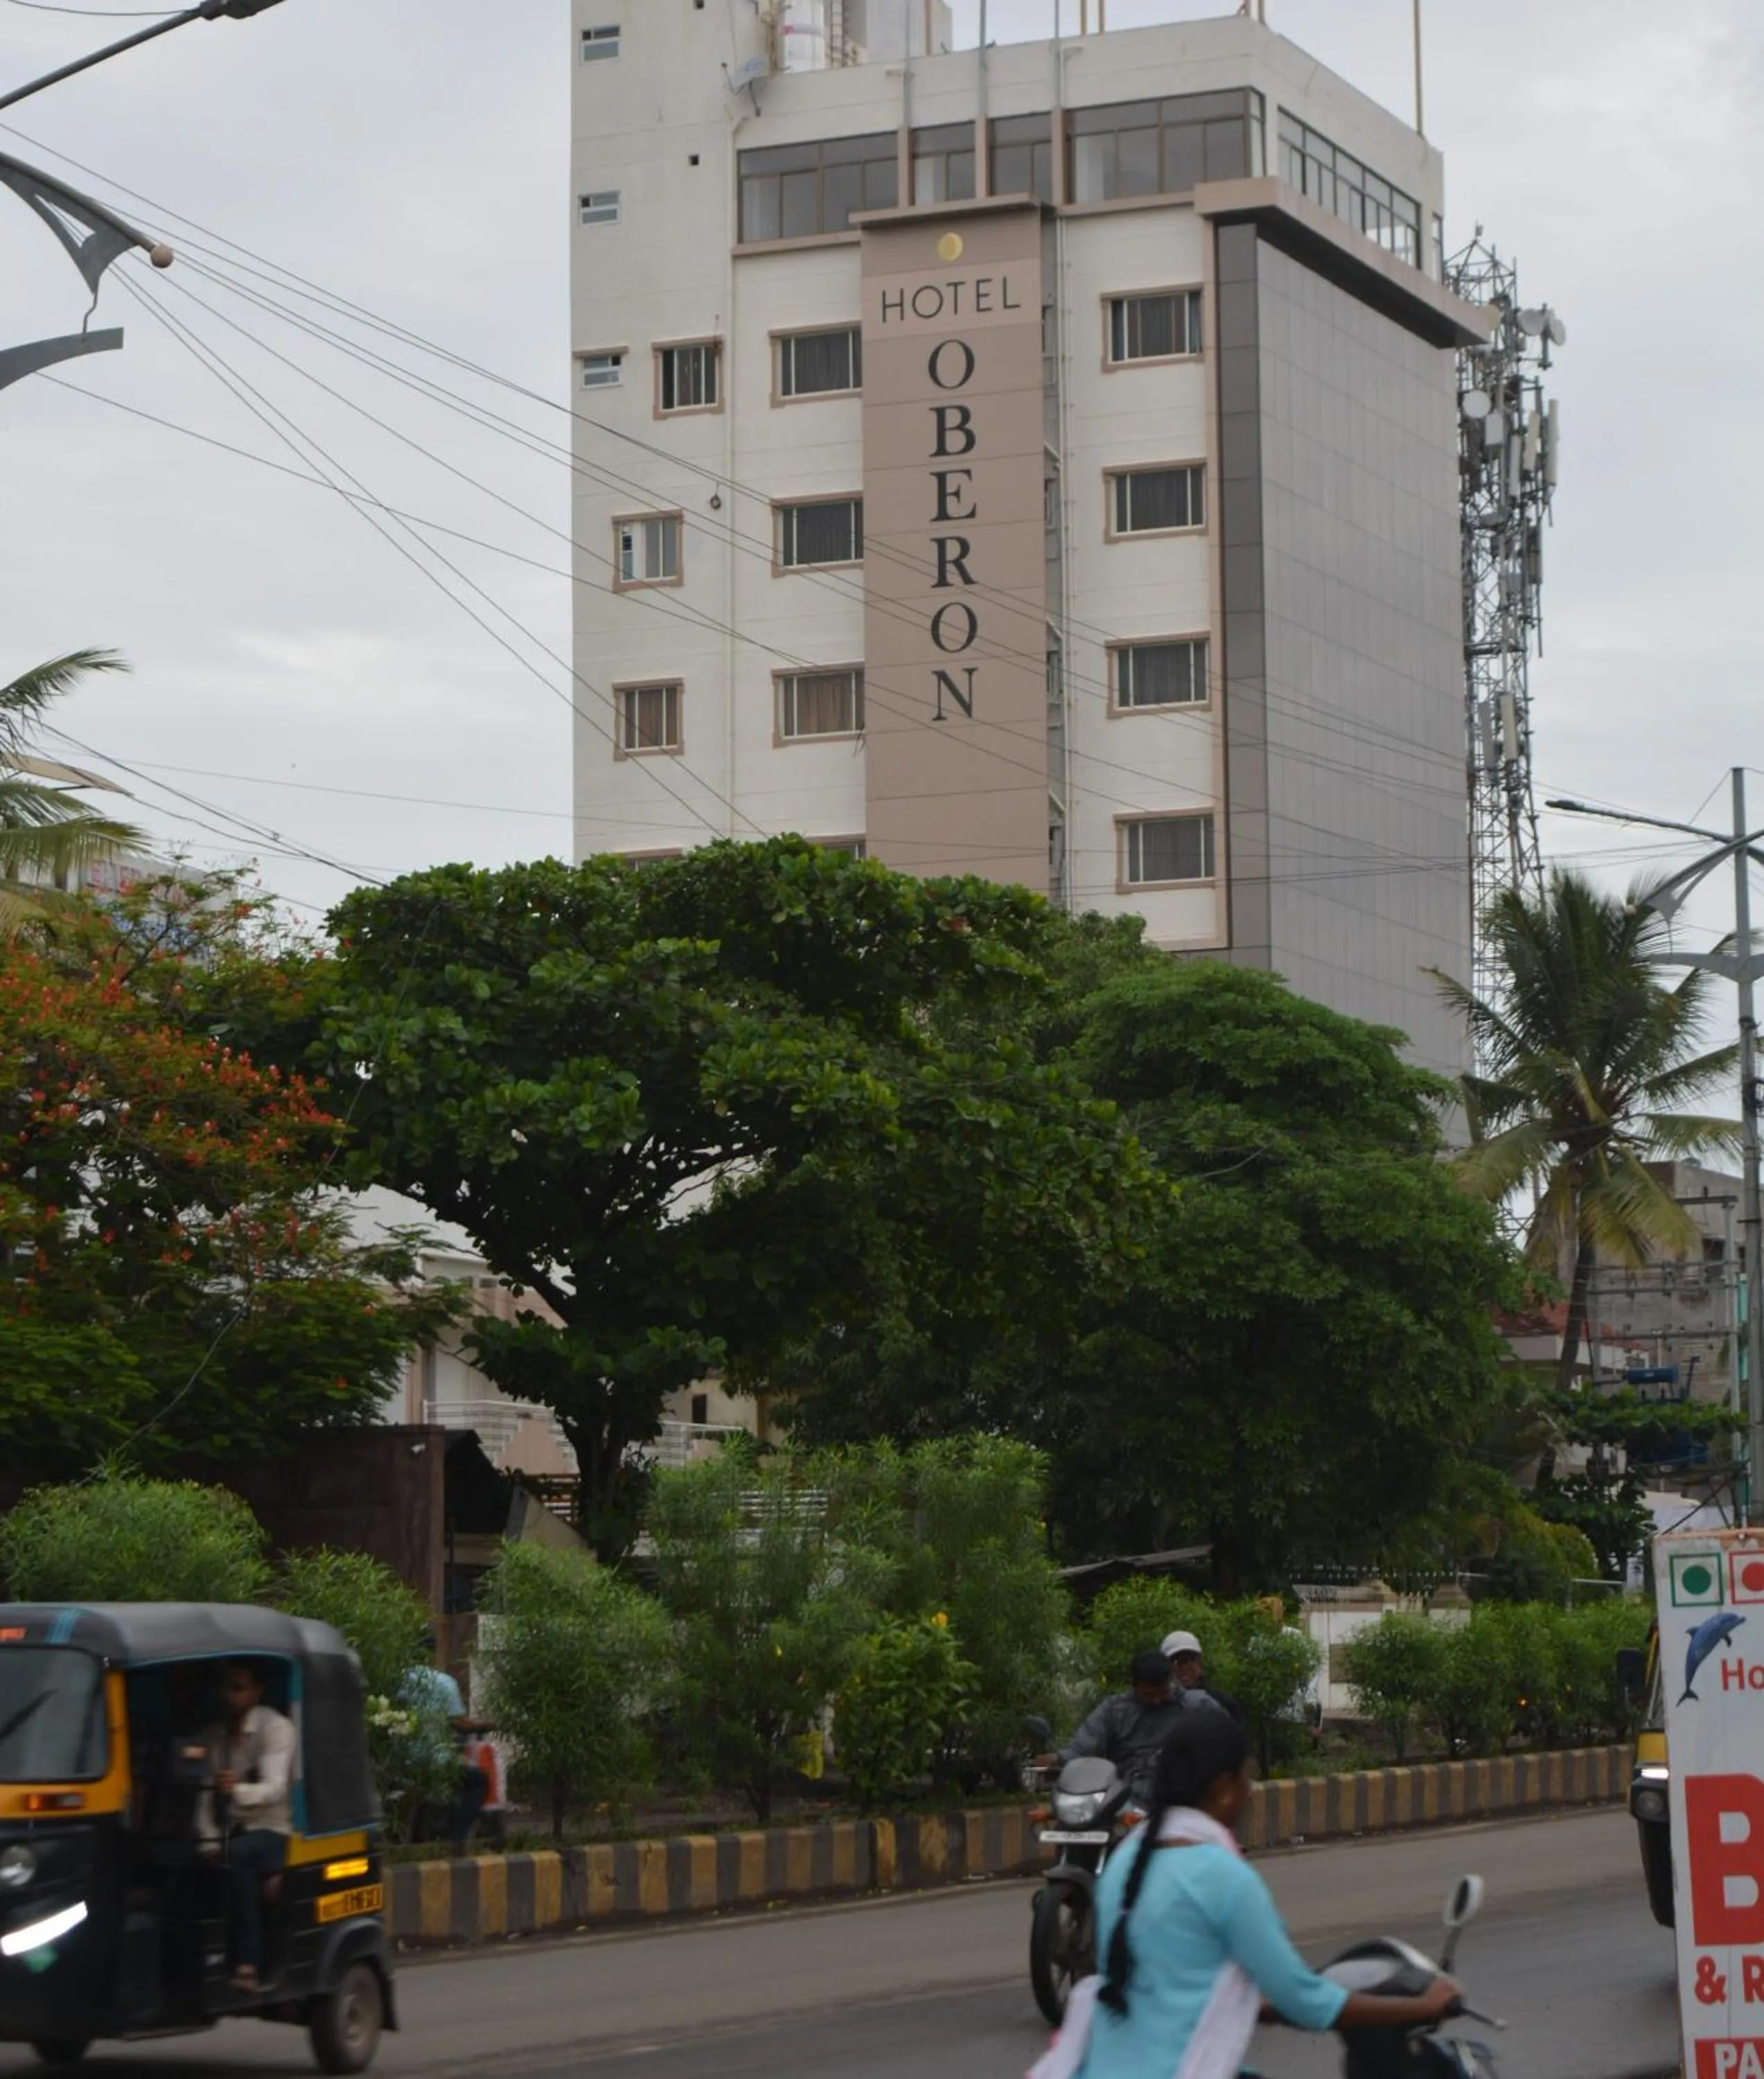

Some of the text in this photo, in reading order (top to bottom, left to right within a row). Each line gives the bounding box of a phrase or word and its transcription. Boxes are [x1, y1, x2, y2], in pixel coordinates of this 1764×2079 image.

[881, 277, 1021, 323] HOTEL
[928, 339, 978, 723] OBERON
[1695, 1955, 1727, 2005] &
